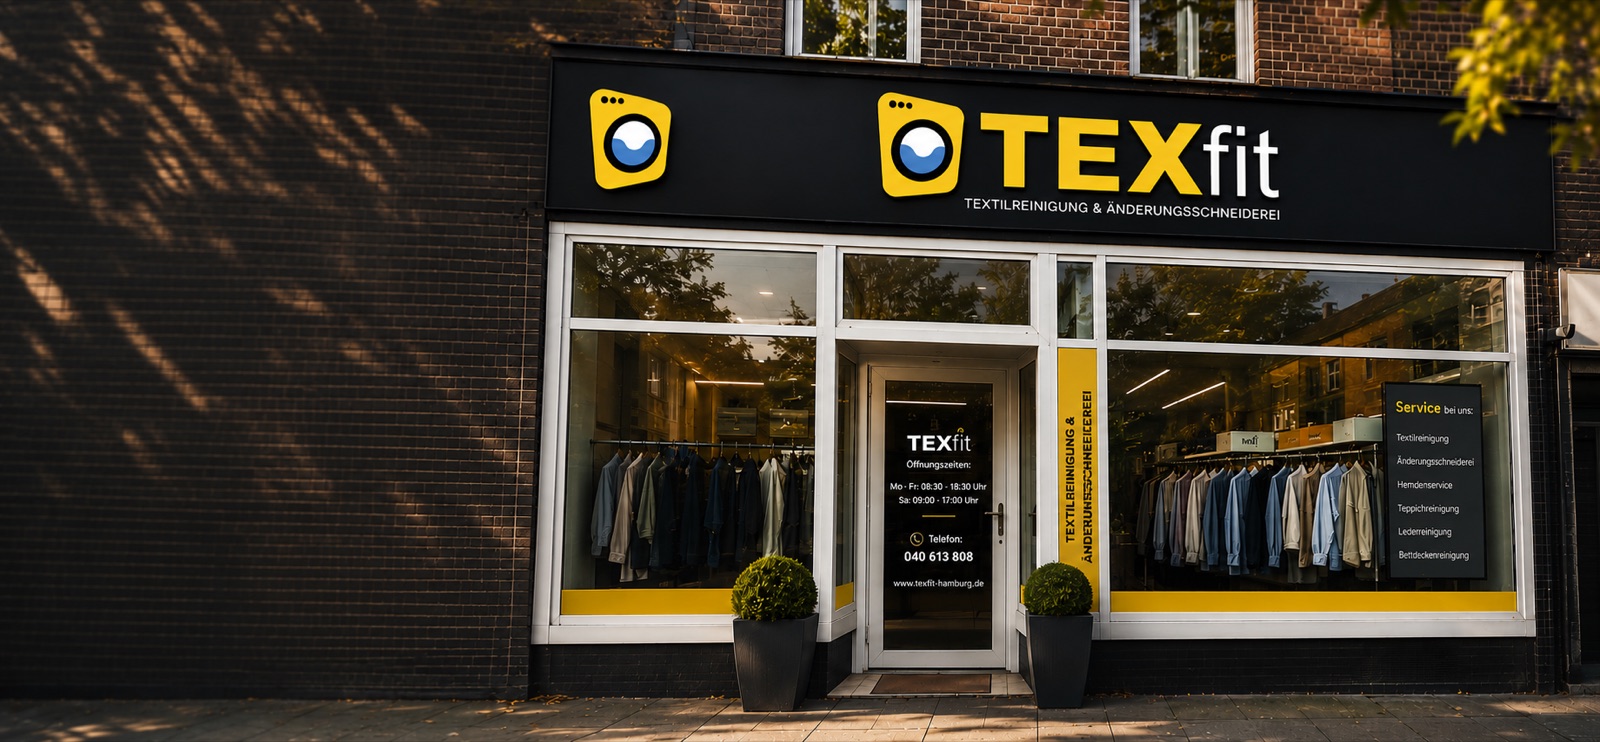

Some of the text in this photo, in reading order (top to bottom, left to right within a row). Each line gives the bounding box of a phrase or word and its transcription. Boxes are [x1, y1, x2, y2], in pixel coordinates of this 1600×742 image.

[980, 112, 1280, 199] TEXfit
[964, 198, 1280, 221] TEXTILREINIGUNG & ÄNDERUNGSSCHNEIDEREI
[1395, 400, 1474, 415] Service bei uns:
[1065, 416, 1075, 426] &
[906, 434, 971, 452] TEXfit
[1396, 433, 1450, 445] Textilreinigung
[1396, 455, 1475, 468] Änderungsschneiderei
[890, 482, 903, 491] Mo
[908, 482, 919, 491] Fr:
[920, 482, 943, 491] 08:30
[950, 482, 971, 491] 18:30
[972, 482, 987, 491] Uhr
[1397, 480, 1453, 490] Hemdenservice
[898, 496, 911, 504] Sa:
[912, 496, 935, 504] 09:00
[942, 496, 963, 504] 17:00
[964, 496, 979, 504] Uhr
[1397, 503, 1460, 515] Teppichreinigung
[1398, 527, 1452, 538] Lederreinigung
[928, 534, 963, 544] Telefon:
[904, 551, 974, 562] 040 613 808
[1398, 550, 1470, 562] Bettdeckenreinigung
[893, 579, 985, 589] www.texfit-hamburg.de
